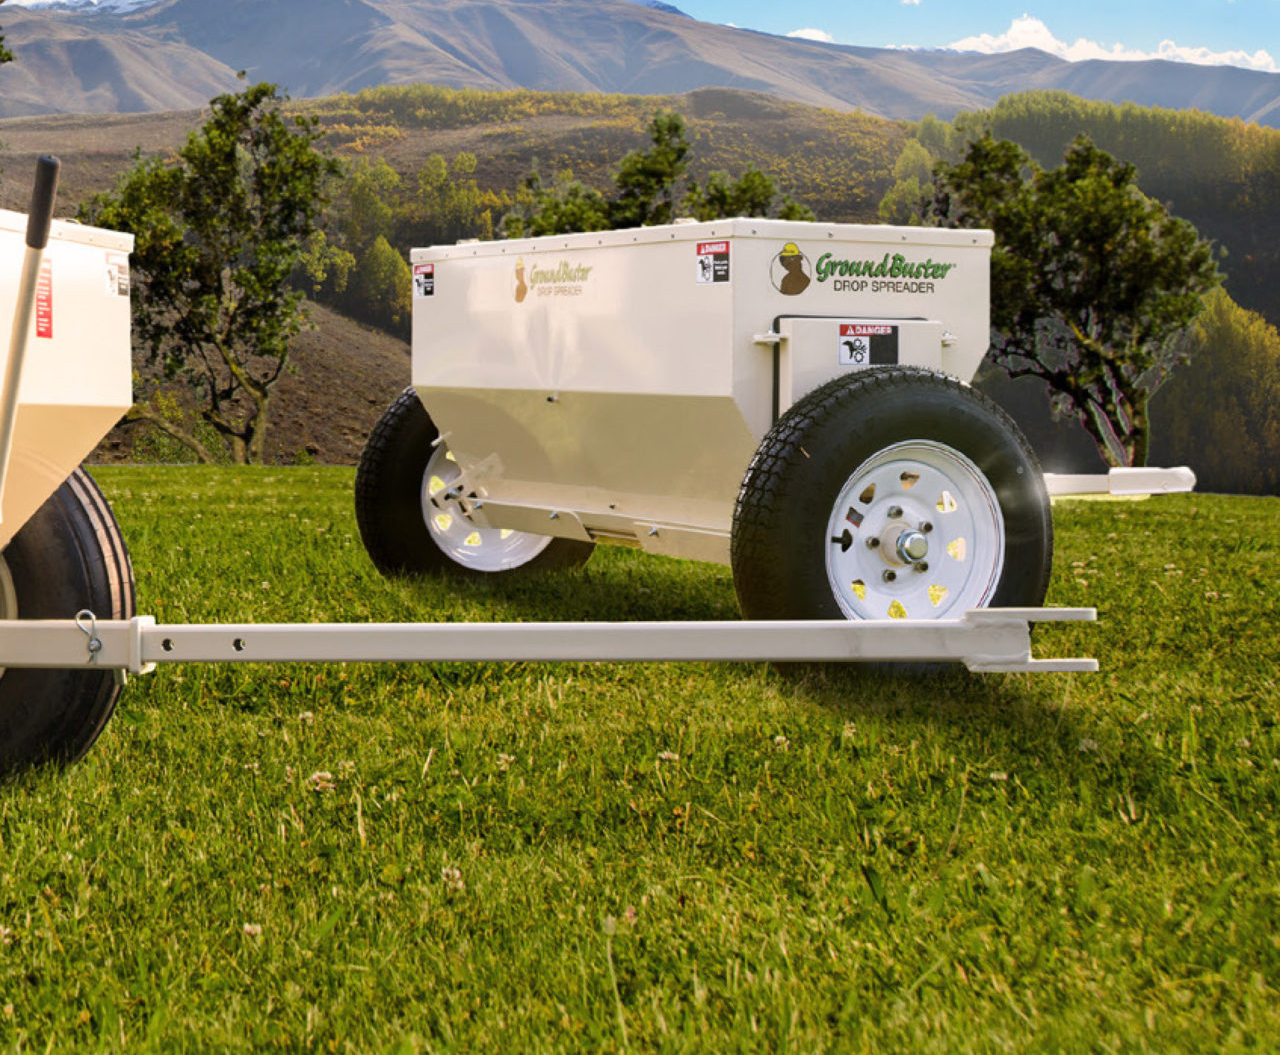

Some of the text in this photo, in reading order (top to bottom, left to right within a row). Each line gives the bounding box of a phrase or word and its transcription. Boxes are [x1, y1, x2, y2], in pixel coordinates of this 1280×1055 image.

[530, 260, 593, 290] GroundBuster
[815, 252, 952, 282] GroundBuster
[833, 280, 935, 294] DROP SPREADER
[855, 326, 893, 335] DANGER
